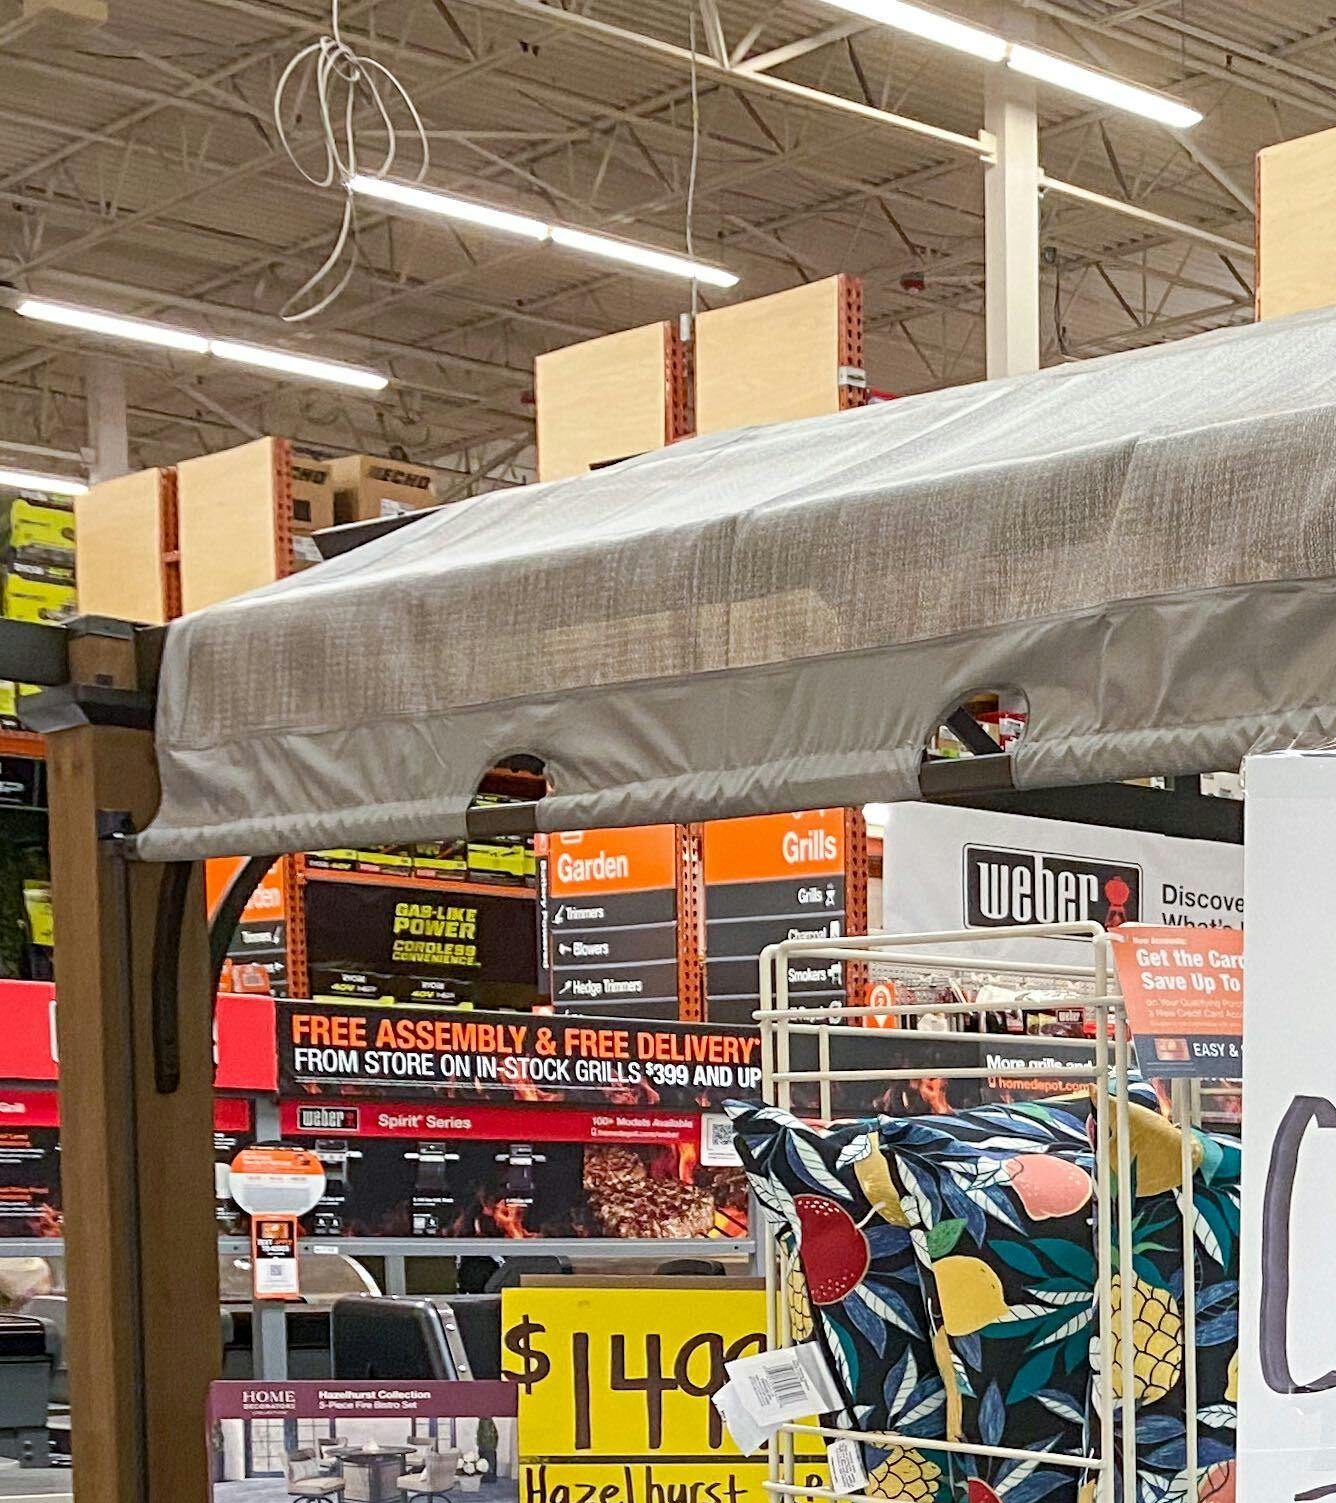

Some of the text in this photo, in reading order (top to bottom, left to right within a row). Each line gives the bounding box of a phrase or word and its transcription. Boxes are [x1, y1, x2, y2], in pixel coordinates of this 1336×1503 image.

[782, 829, 838, 863] Grills
[557, 851, 629, 883] Garden
[798, 887, 824, 904] Grills
[976, 853, 1099, 924] weber
[1161, 884, 1245, 912] Discove
[394, 902, 478, 923] GAS-LIKE
[565, 905, 605, 920] Trimmers
[392, 916, 477, 940] POWER
[393, 939, 477, 957] CORDLESS
[572, 941, 609, 957] Blowers
[1135, 948, 1170, 967] Get
[1173, 949, 1204, 968] the
[787, 967, 828, 984] Smokers
[1141, 972, 1241, 995] Save Up To
[572, 978, 643, 997] Hedge Trimmers
[291, 1014, 367, 1047] FREE
[375, 1018, 528, 1054] ASSEMBLY
[534, 1027, 557, 1056] &
[564, 1028, 632, 1060] FREE
[1192, 1043, 1240, 1058] EASY &
[293, 1047, 762, 1089] FROM STORE ON IN-STOCK GRILLS $399 AND UP
[985, 1054, 1026, 1070] More
[302, 1108, 345, 1128] weber
[425, 1114, 473, 1130] Series
[242, 1390, 296, 1402] HOME
[378, 1390, 432, 1400] Collection
